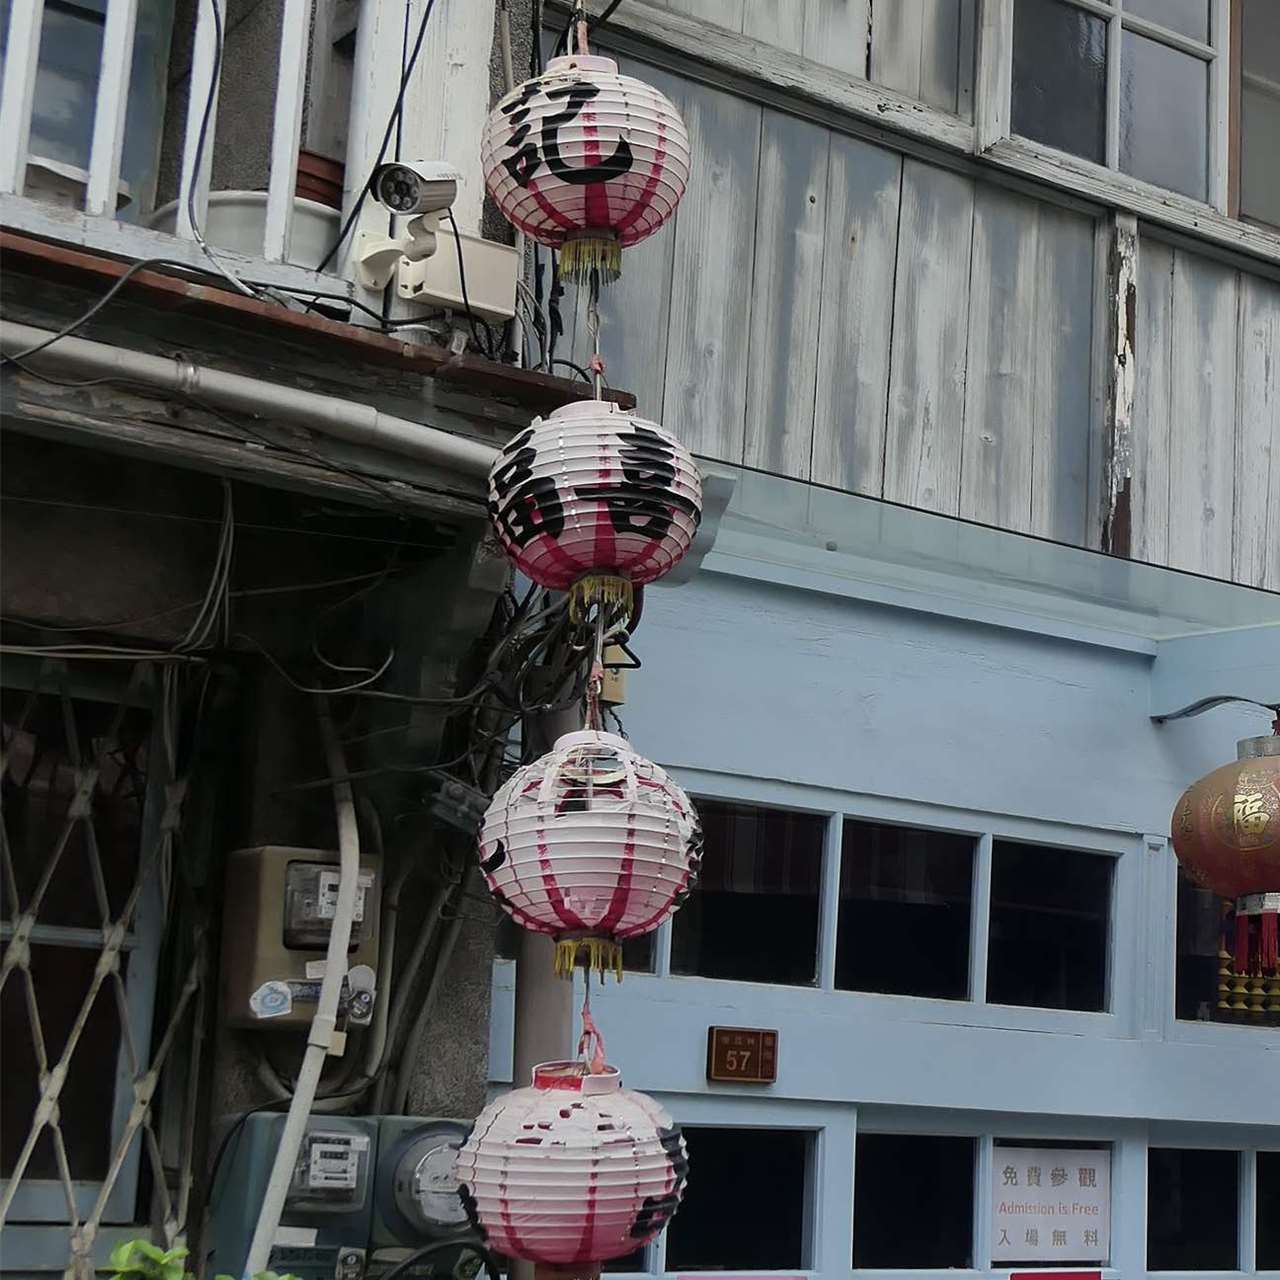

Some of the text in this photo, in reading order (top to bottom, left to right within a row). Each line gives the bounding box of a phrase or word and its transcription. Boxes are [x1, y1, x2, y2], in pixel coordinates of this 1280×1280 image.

[500, 81, 634, 186] 記
[726, 1049, 751, 1071] 57
[1002, 1164, 1097, 1188] 免費參觀
[998, 1201, 1100, 1216] Admission is Free
